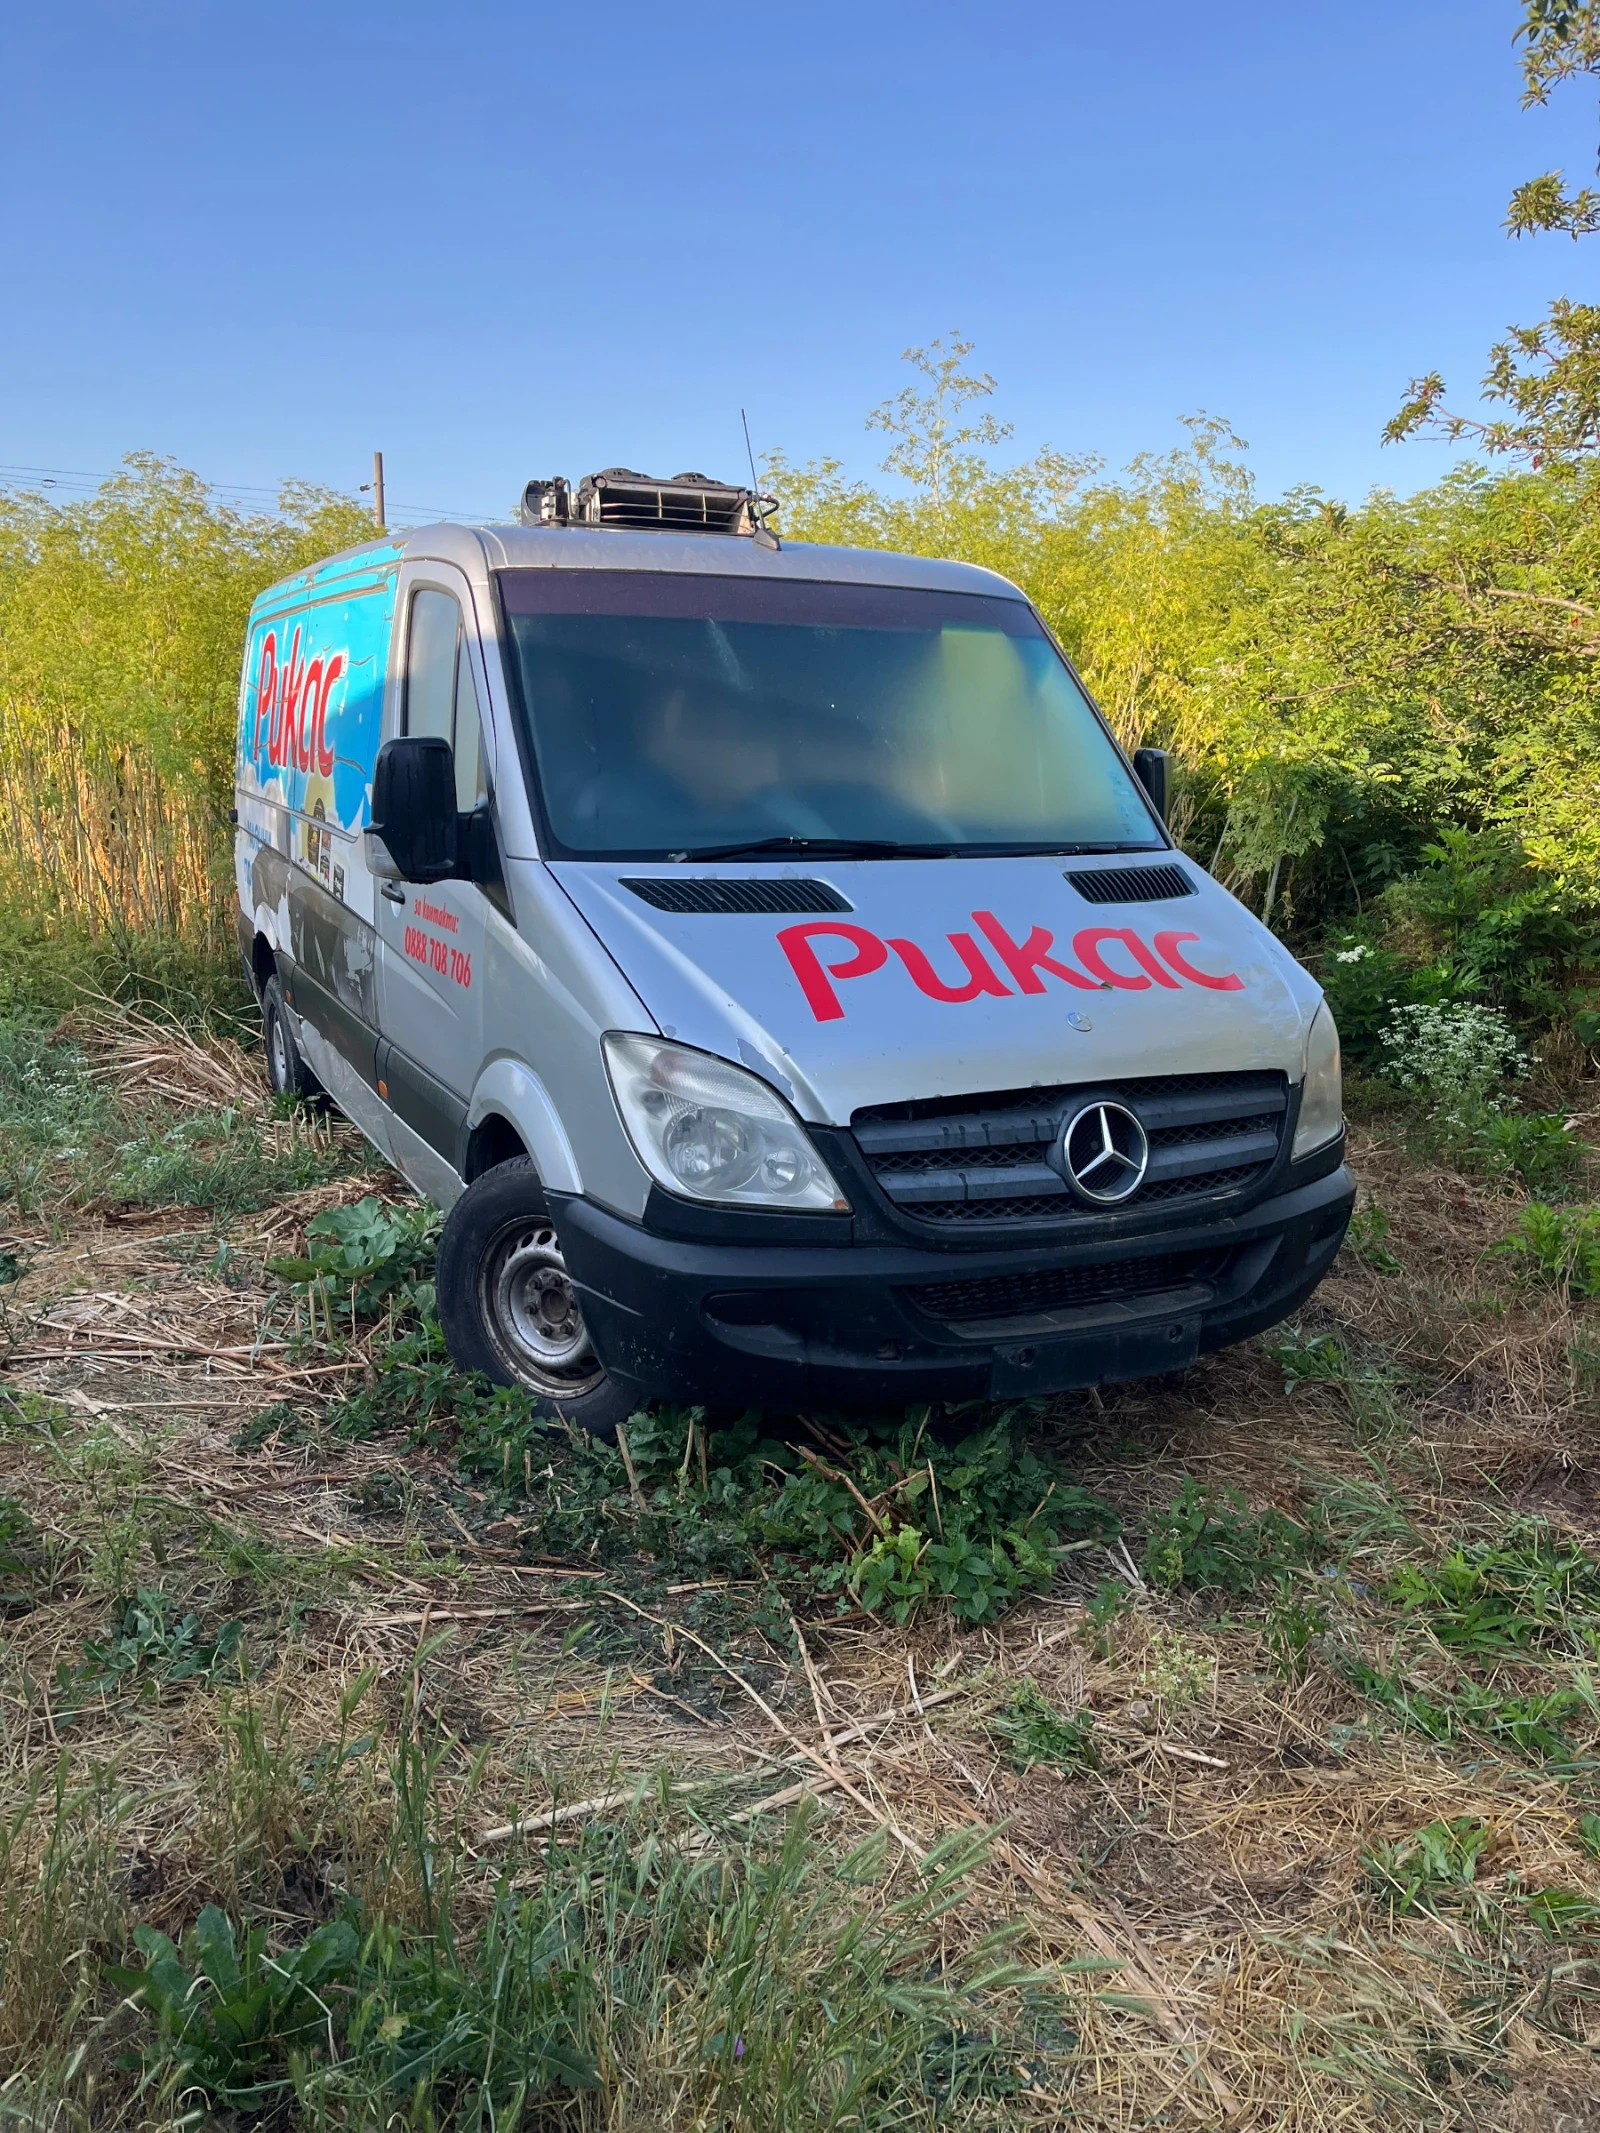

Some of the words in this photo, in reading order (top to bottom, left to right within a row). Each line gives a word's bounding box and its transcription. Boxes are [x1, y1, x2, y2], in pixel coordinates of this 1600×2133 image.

[404, 925, 427, 964] 0888
[430, 938, 448, 975] 708
[450, 948, 471, 989] 706
